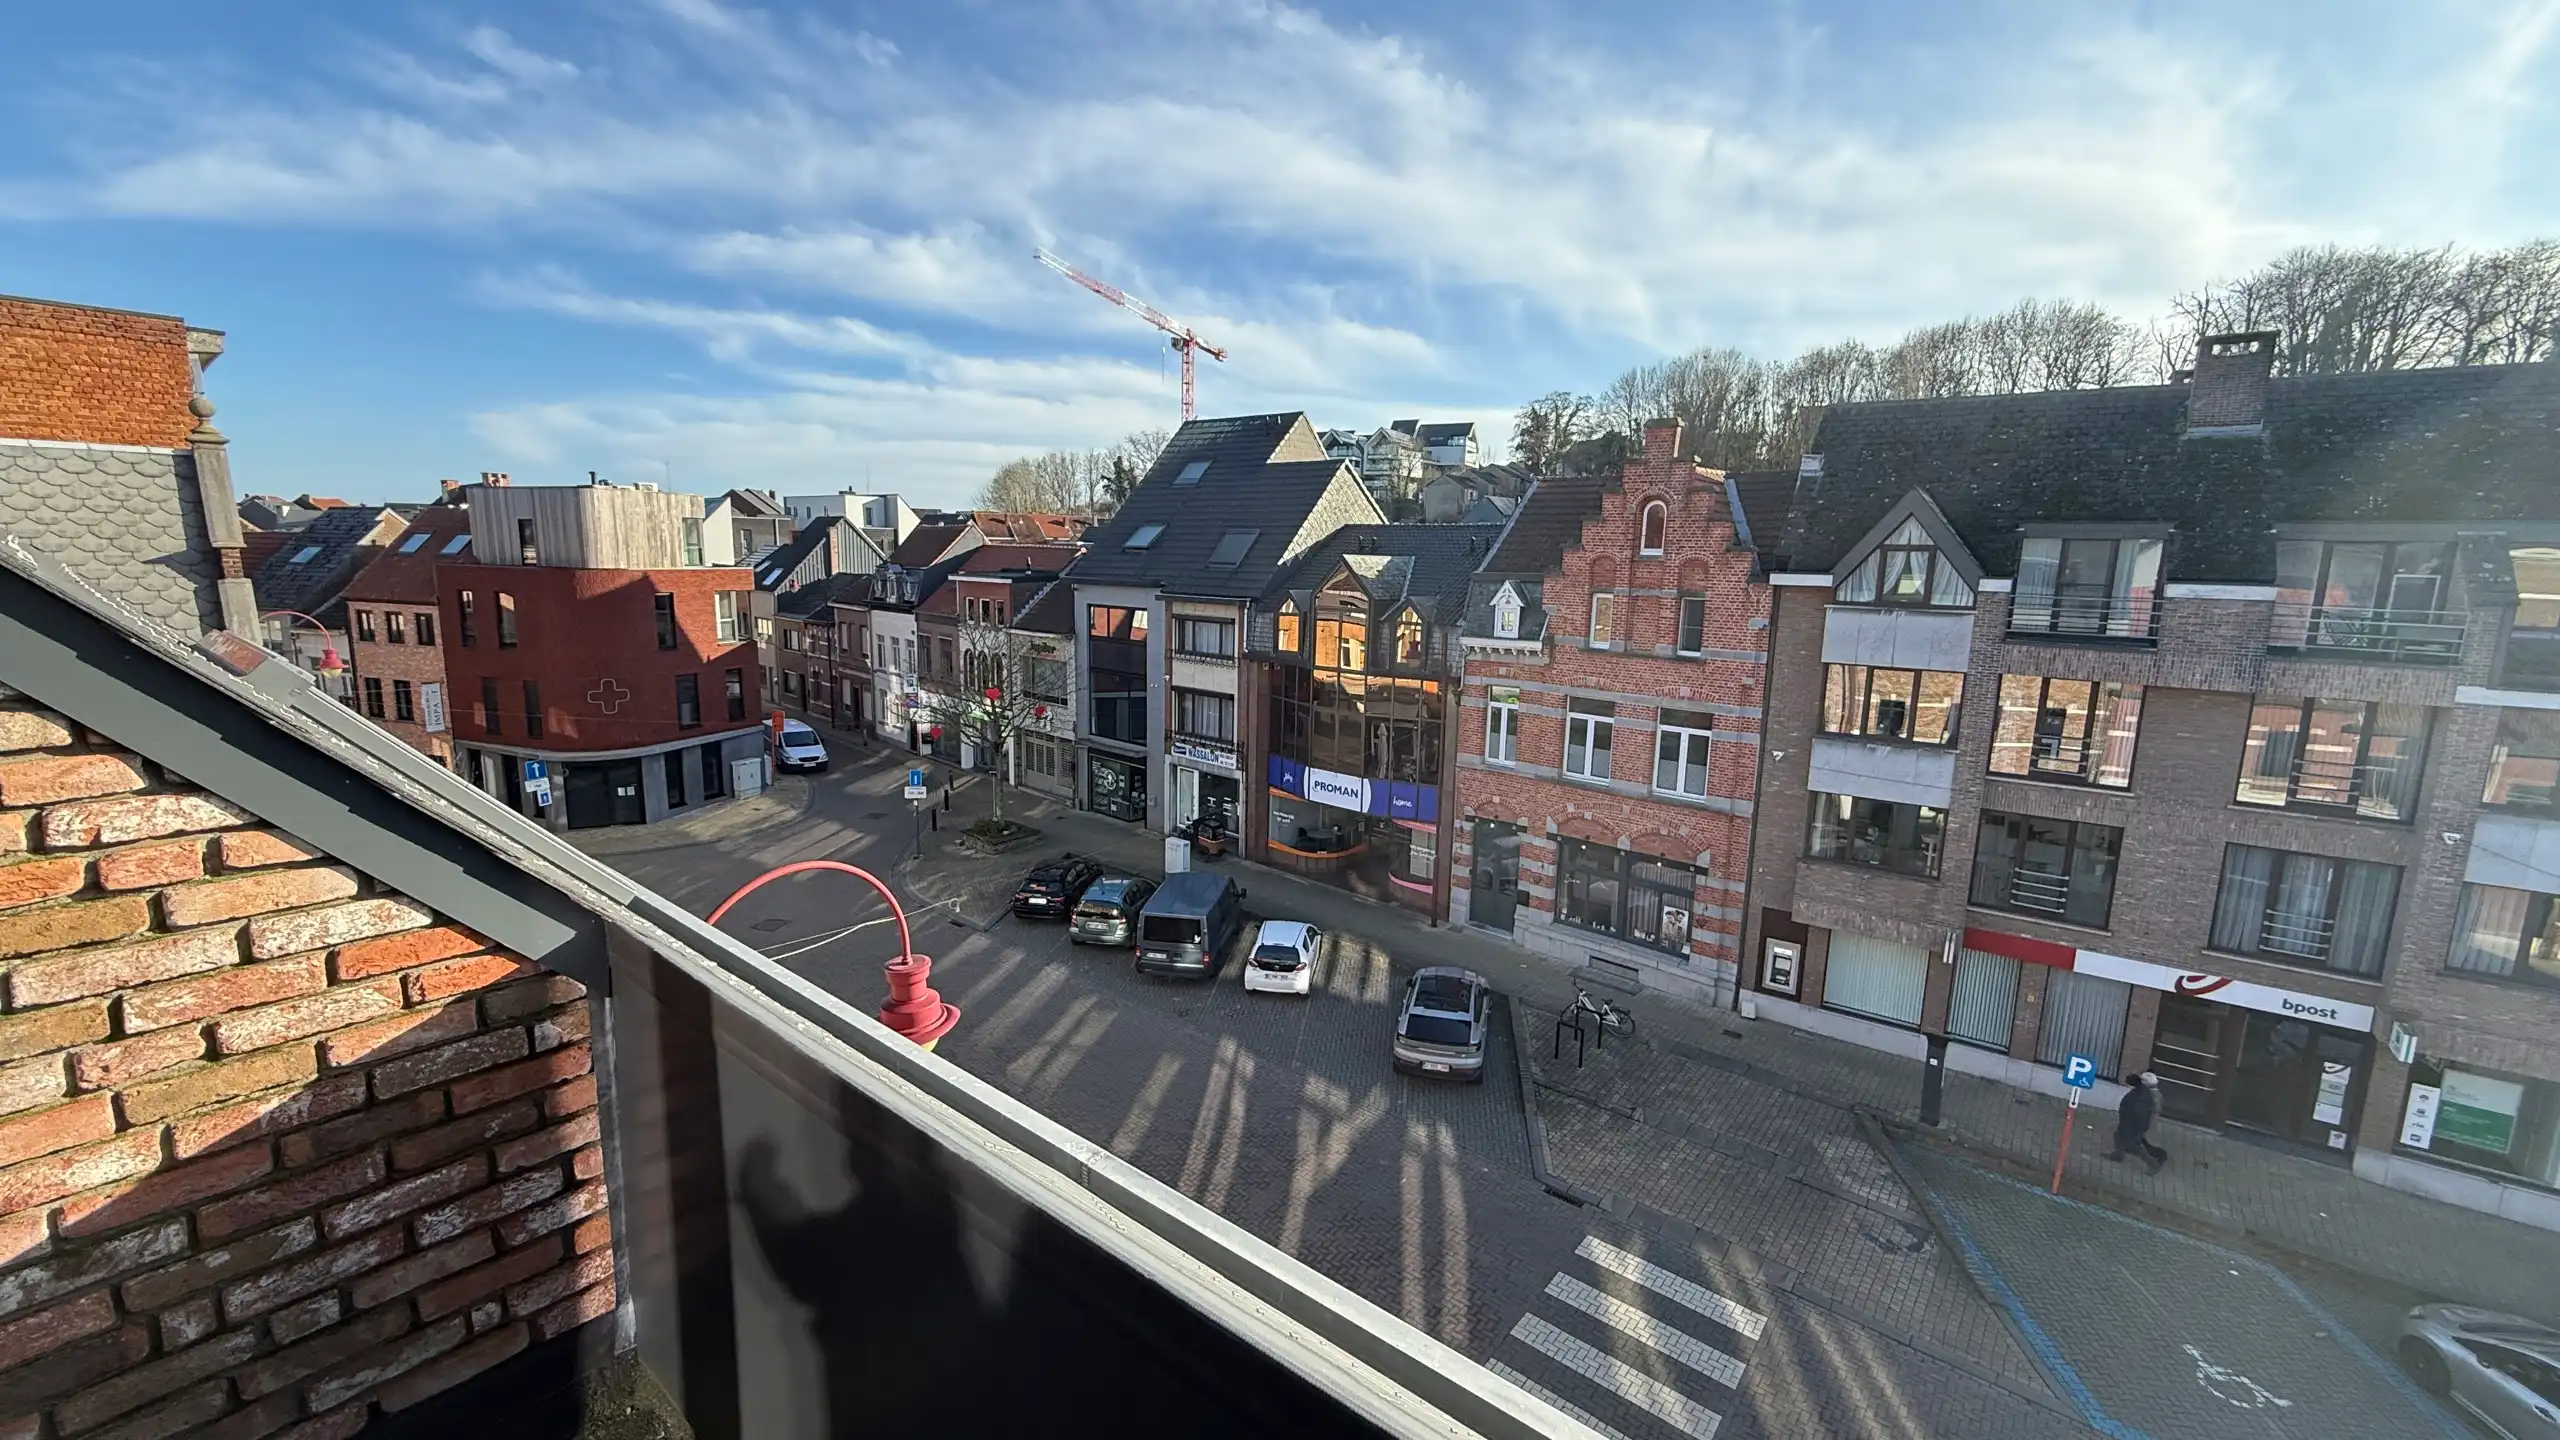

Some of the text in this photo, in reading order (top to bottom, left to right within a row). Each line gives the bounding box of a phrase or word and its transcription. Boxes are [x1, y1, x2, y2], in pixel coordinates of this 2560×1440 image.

[1188, 747, 1219, 764] WASSALON
[1314, 780, 1359, 799] PROMAN
[1393, 796, 1413, 807] home
[2282, 998, 2338, 1020] bpost
[2067, 1056, 2092, 1080] P
